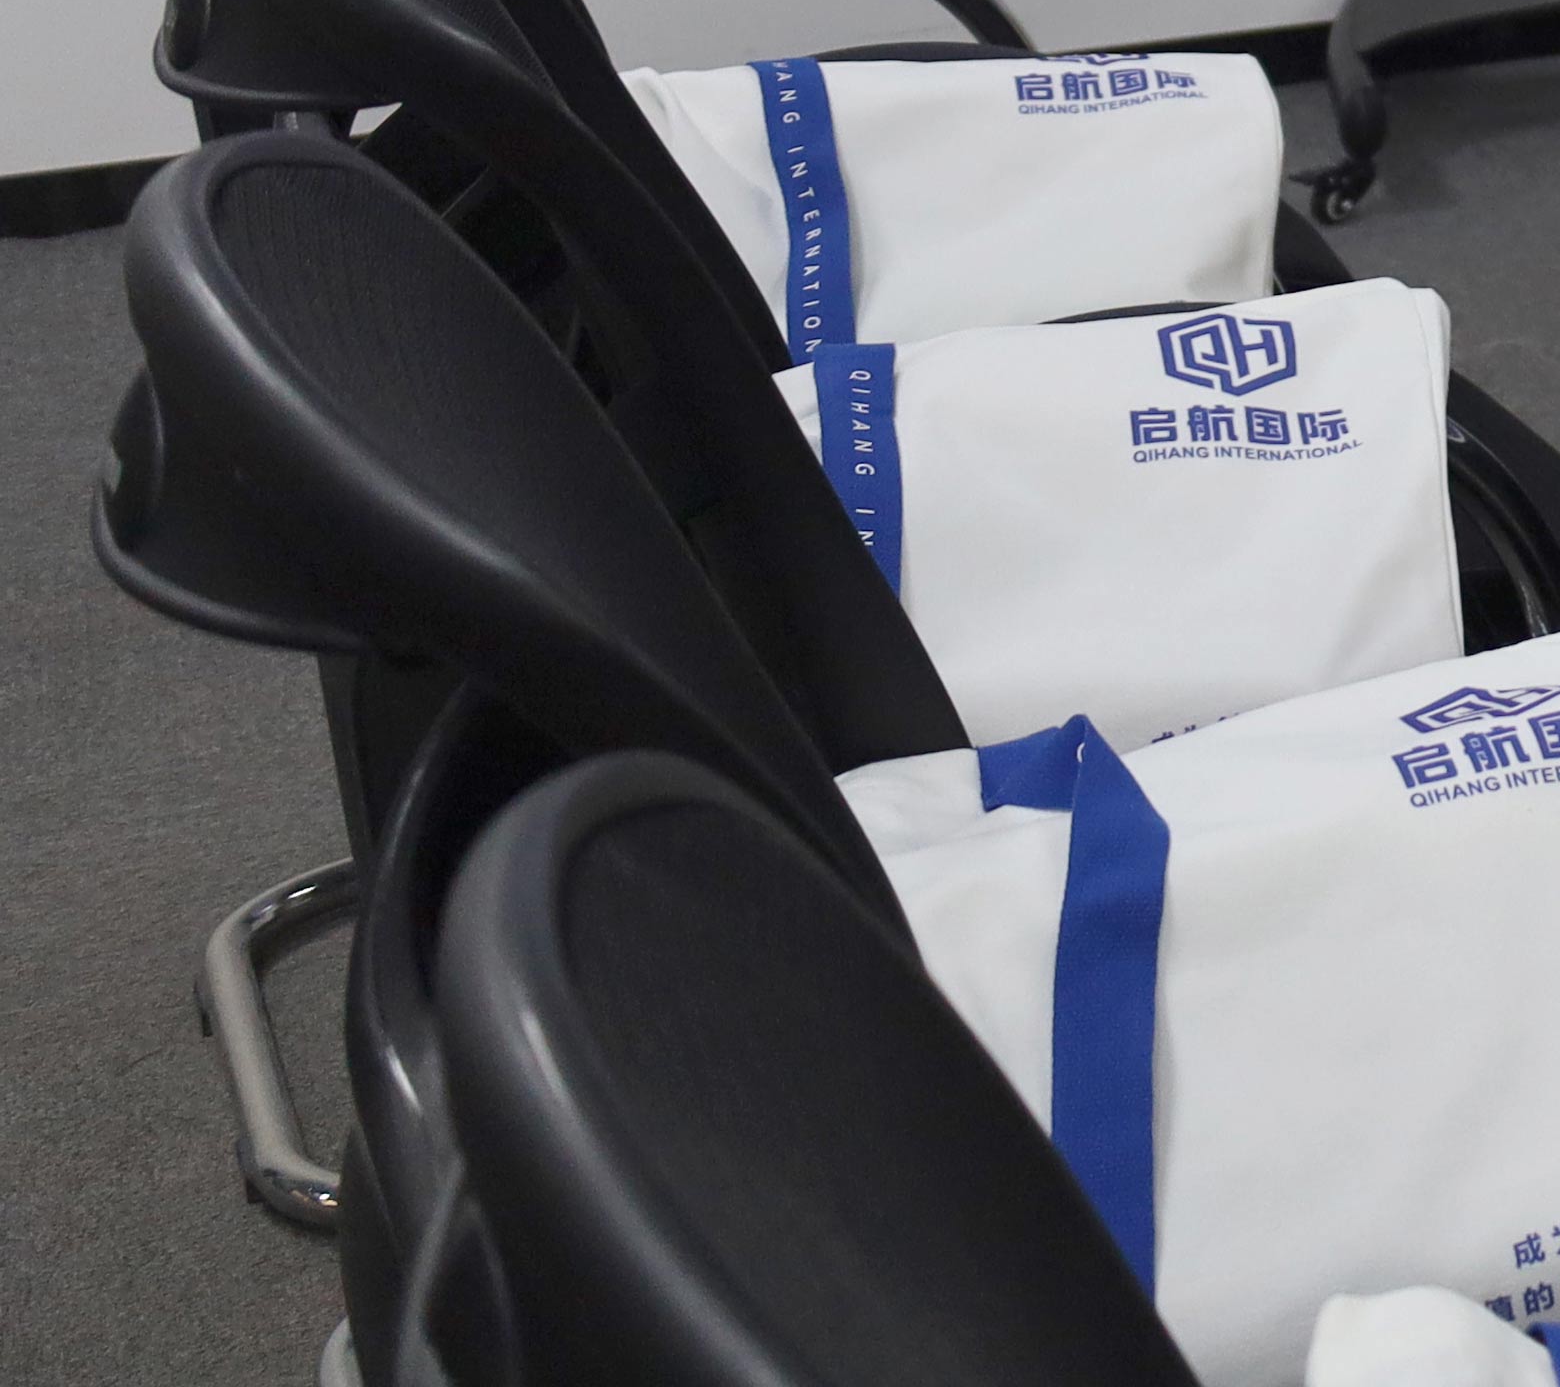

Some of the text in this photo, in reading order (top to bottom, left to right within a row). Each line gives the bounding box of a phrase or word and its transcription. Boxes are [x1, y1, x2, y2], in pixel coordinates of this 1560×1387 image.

[1014, 68, 1197, 102] 启航国际
[1018, 90, 1208, 115] QIHANG INTERNATIONAL
[849, 369, 876, 477] QIHANG
[1130, 405, 1350, 446] 启航国际
[1133, 439, 1363, 463] QIHANG INTERNATIONAL
[1410, 776, 1502, 809] QIHANG
